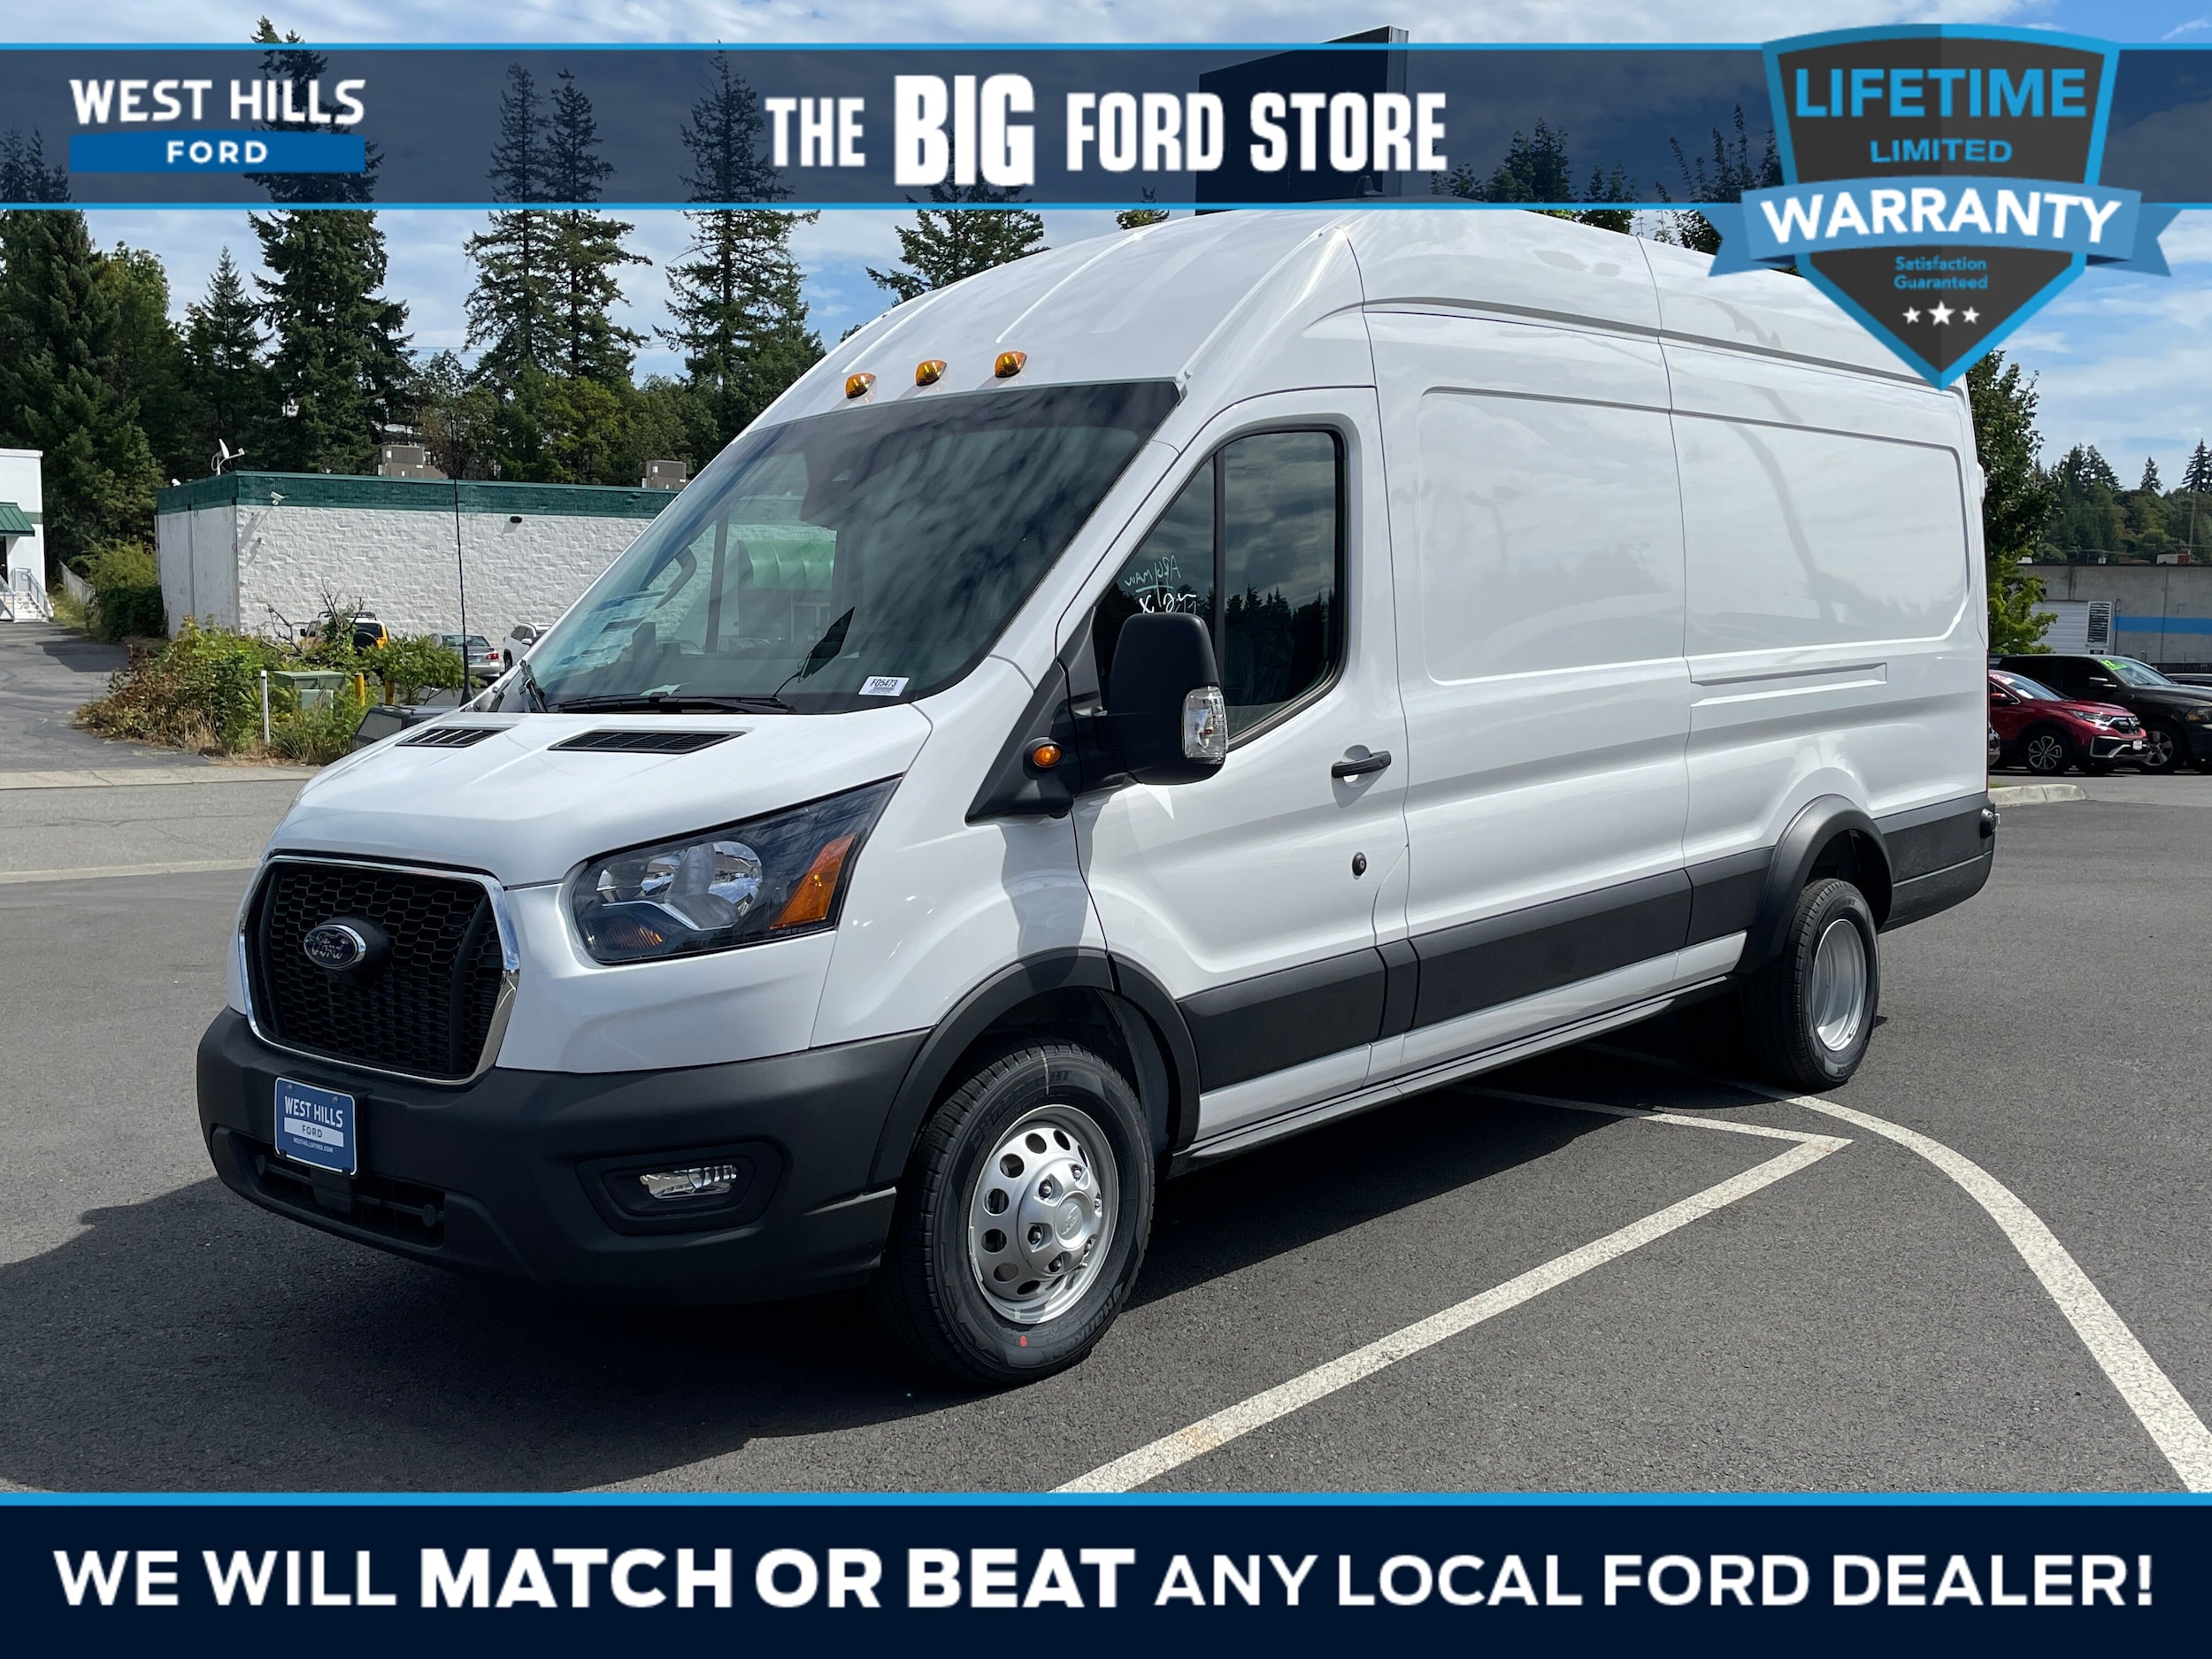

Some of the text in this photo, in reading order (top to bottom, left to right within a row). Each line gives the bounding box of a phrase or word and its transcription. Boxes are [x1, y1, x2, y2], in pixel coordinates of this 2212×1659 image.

[284, 1095, 343, 1128] WEST HILLS
[302, 1125, 323, 1138] FORD
